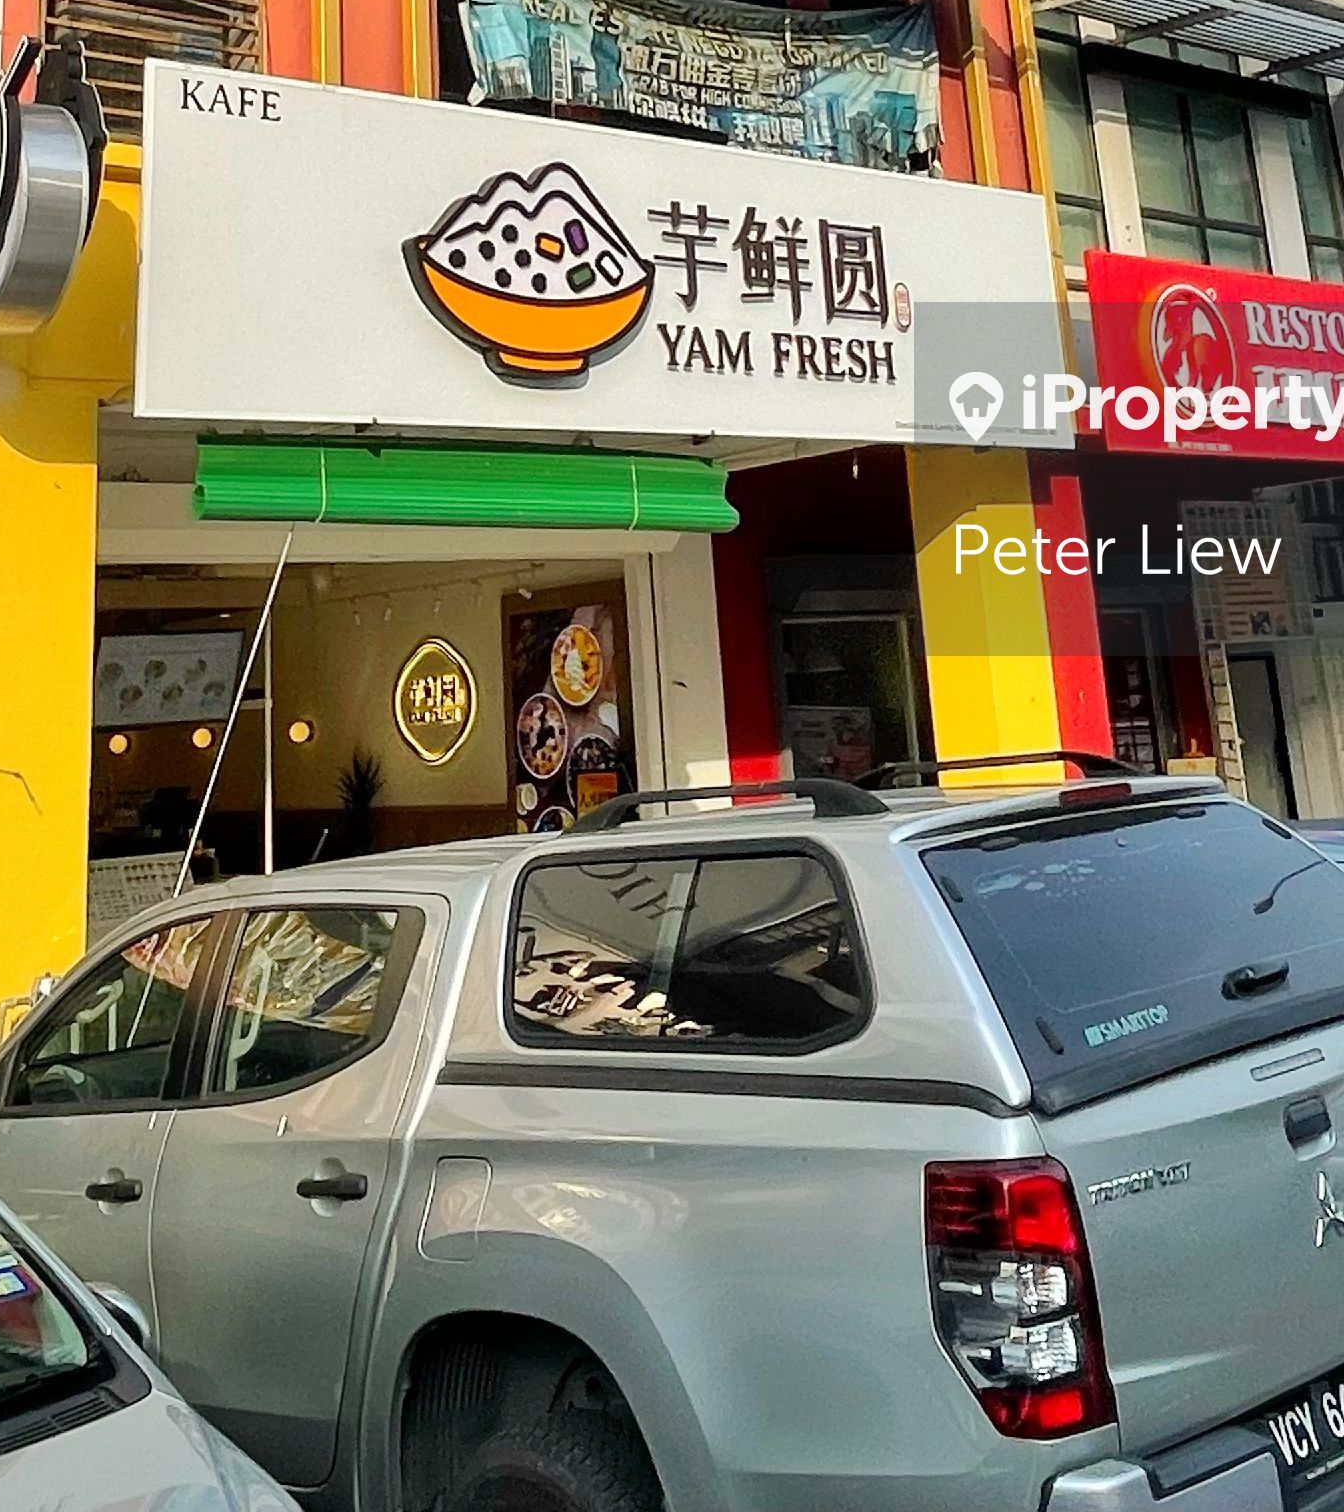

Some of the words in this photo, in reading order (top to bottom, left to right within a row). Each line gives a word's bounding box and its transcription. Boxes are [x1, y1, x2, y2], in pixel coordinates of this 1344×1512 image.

[180, 77, 283, 124] KAFE
[700, 88, 732, 107] HIGH
[646, 200, 891, 328] 芋鲜圆
[658, 322, 754, 376] YAM
[773, 331, 899, 384] FRESH
[1269, 1401, 1319, 1467] VCY
